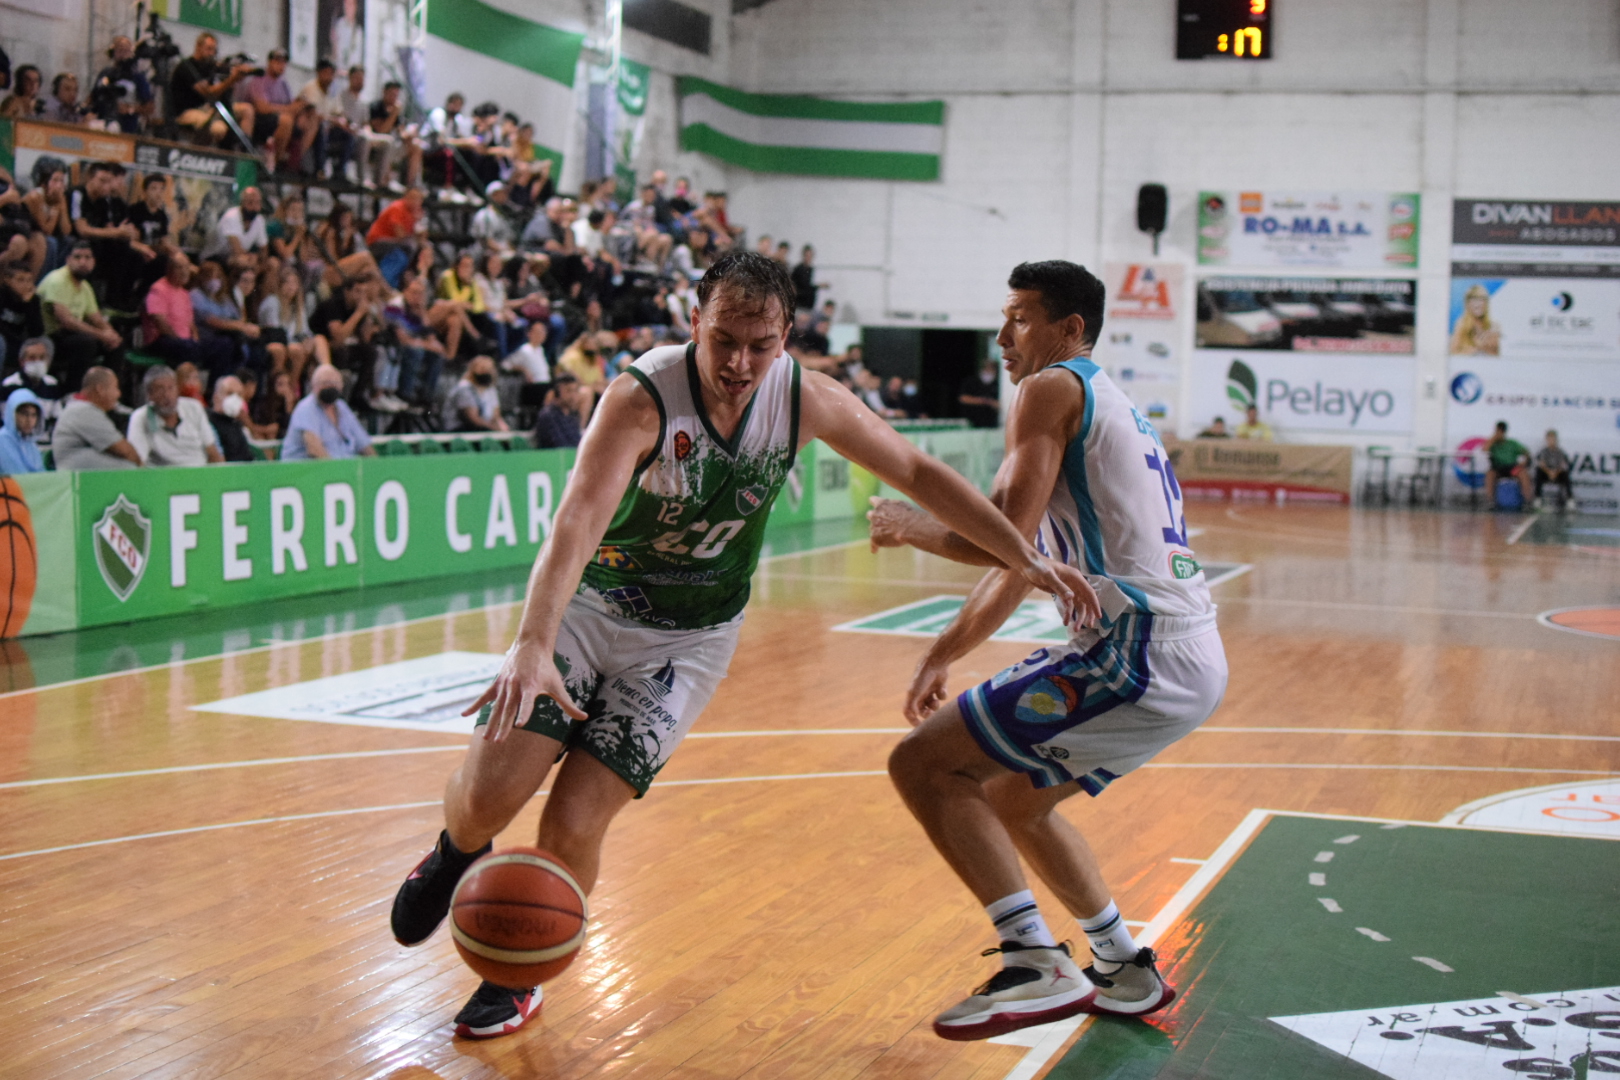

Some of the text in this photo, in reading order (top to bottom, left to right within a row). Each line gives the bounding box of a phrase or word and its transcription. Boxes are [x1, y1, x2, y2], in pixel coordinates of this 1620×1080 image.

[1266, 379, 1395, 426] Pelayo
[168, 471, 575, 588] FERRO CAR
[657, 500, 684, 526] 12
[109, 523, 137, 568] FCO
[611, 677, 640, 701] Viento
[639, 696, 654, 711] en
